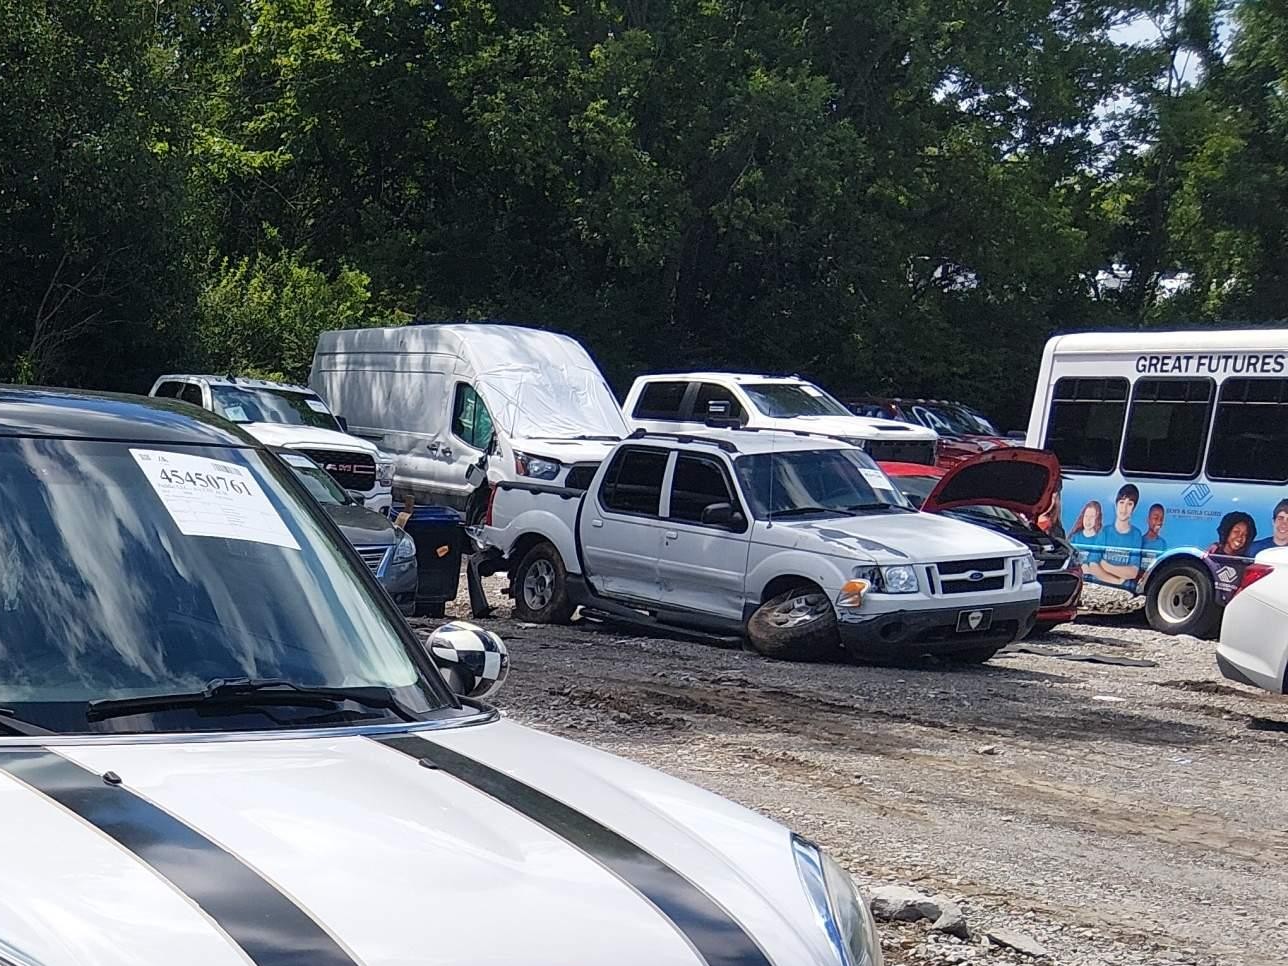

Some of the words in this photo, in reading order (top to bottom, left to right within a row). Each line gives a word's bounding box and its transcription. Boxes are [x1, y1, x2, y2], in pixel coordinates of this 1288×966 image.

[1135, 355, 1194, 374] GREAT
[1196, 354, 1286, 373] FUTURES
[160, 468, 252, 497] 45450761
